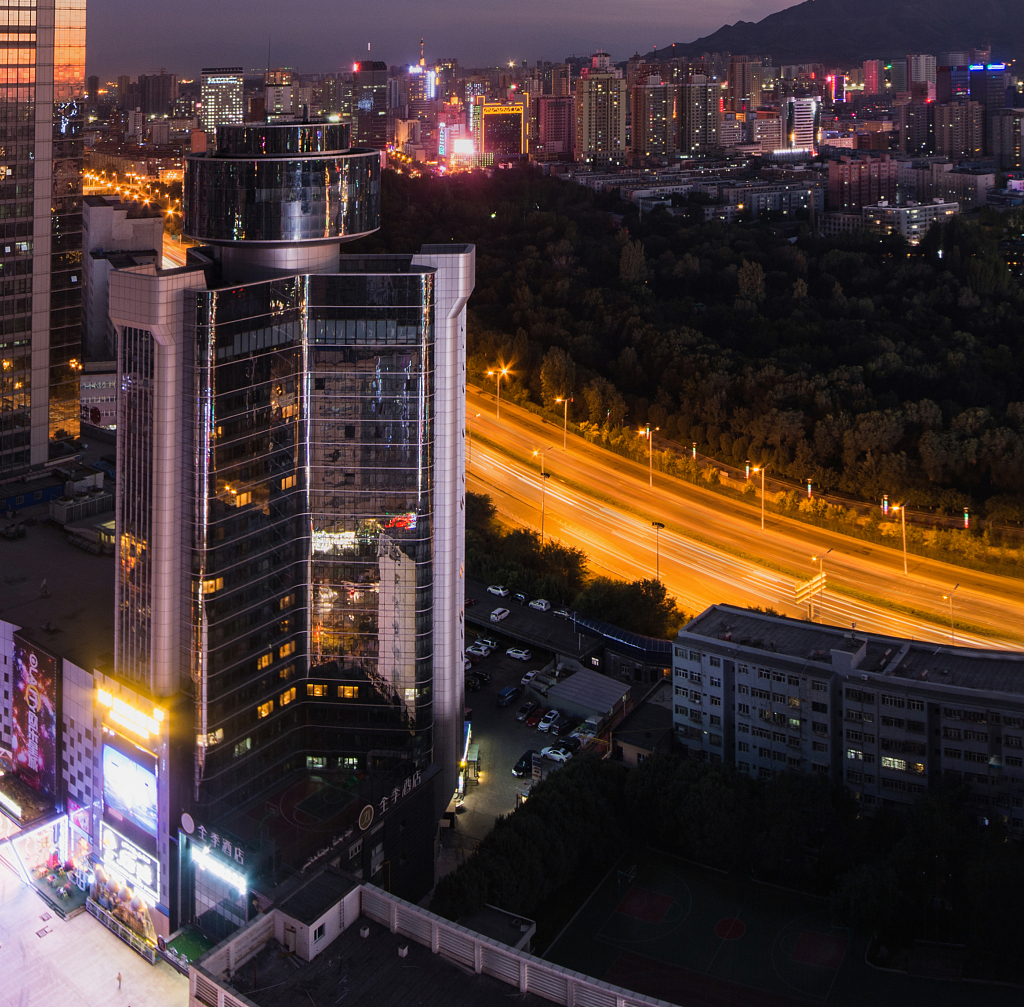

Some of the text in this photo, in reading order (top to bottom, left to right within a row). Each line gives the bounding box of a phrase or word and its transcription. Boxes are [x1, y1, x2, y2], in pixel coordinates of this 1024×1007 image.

[378, 769, 421, 816] 全季酒店
[197, 824, 245, 865] 全季酒店
